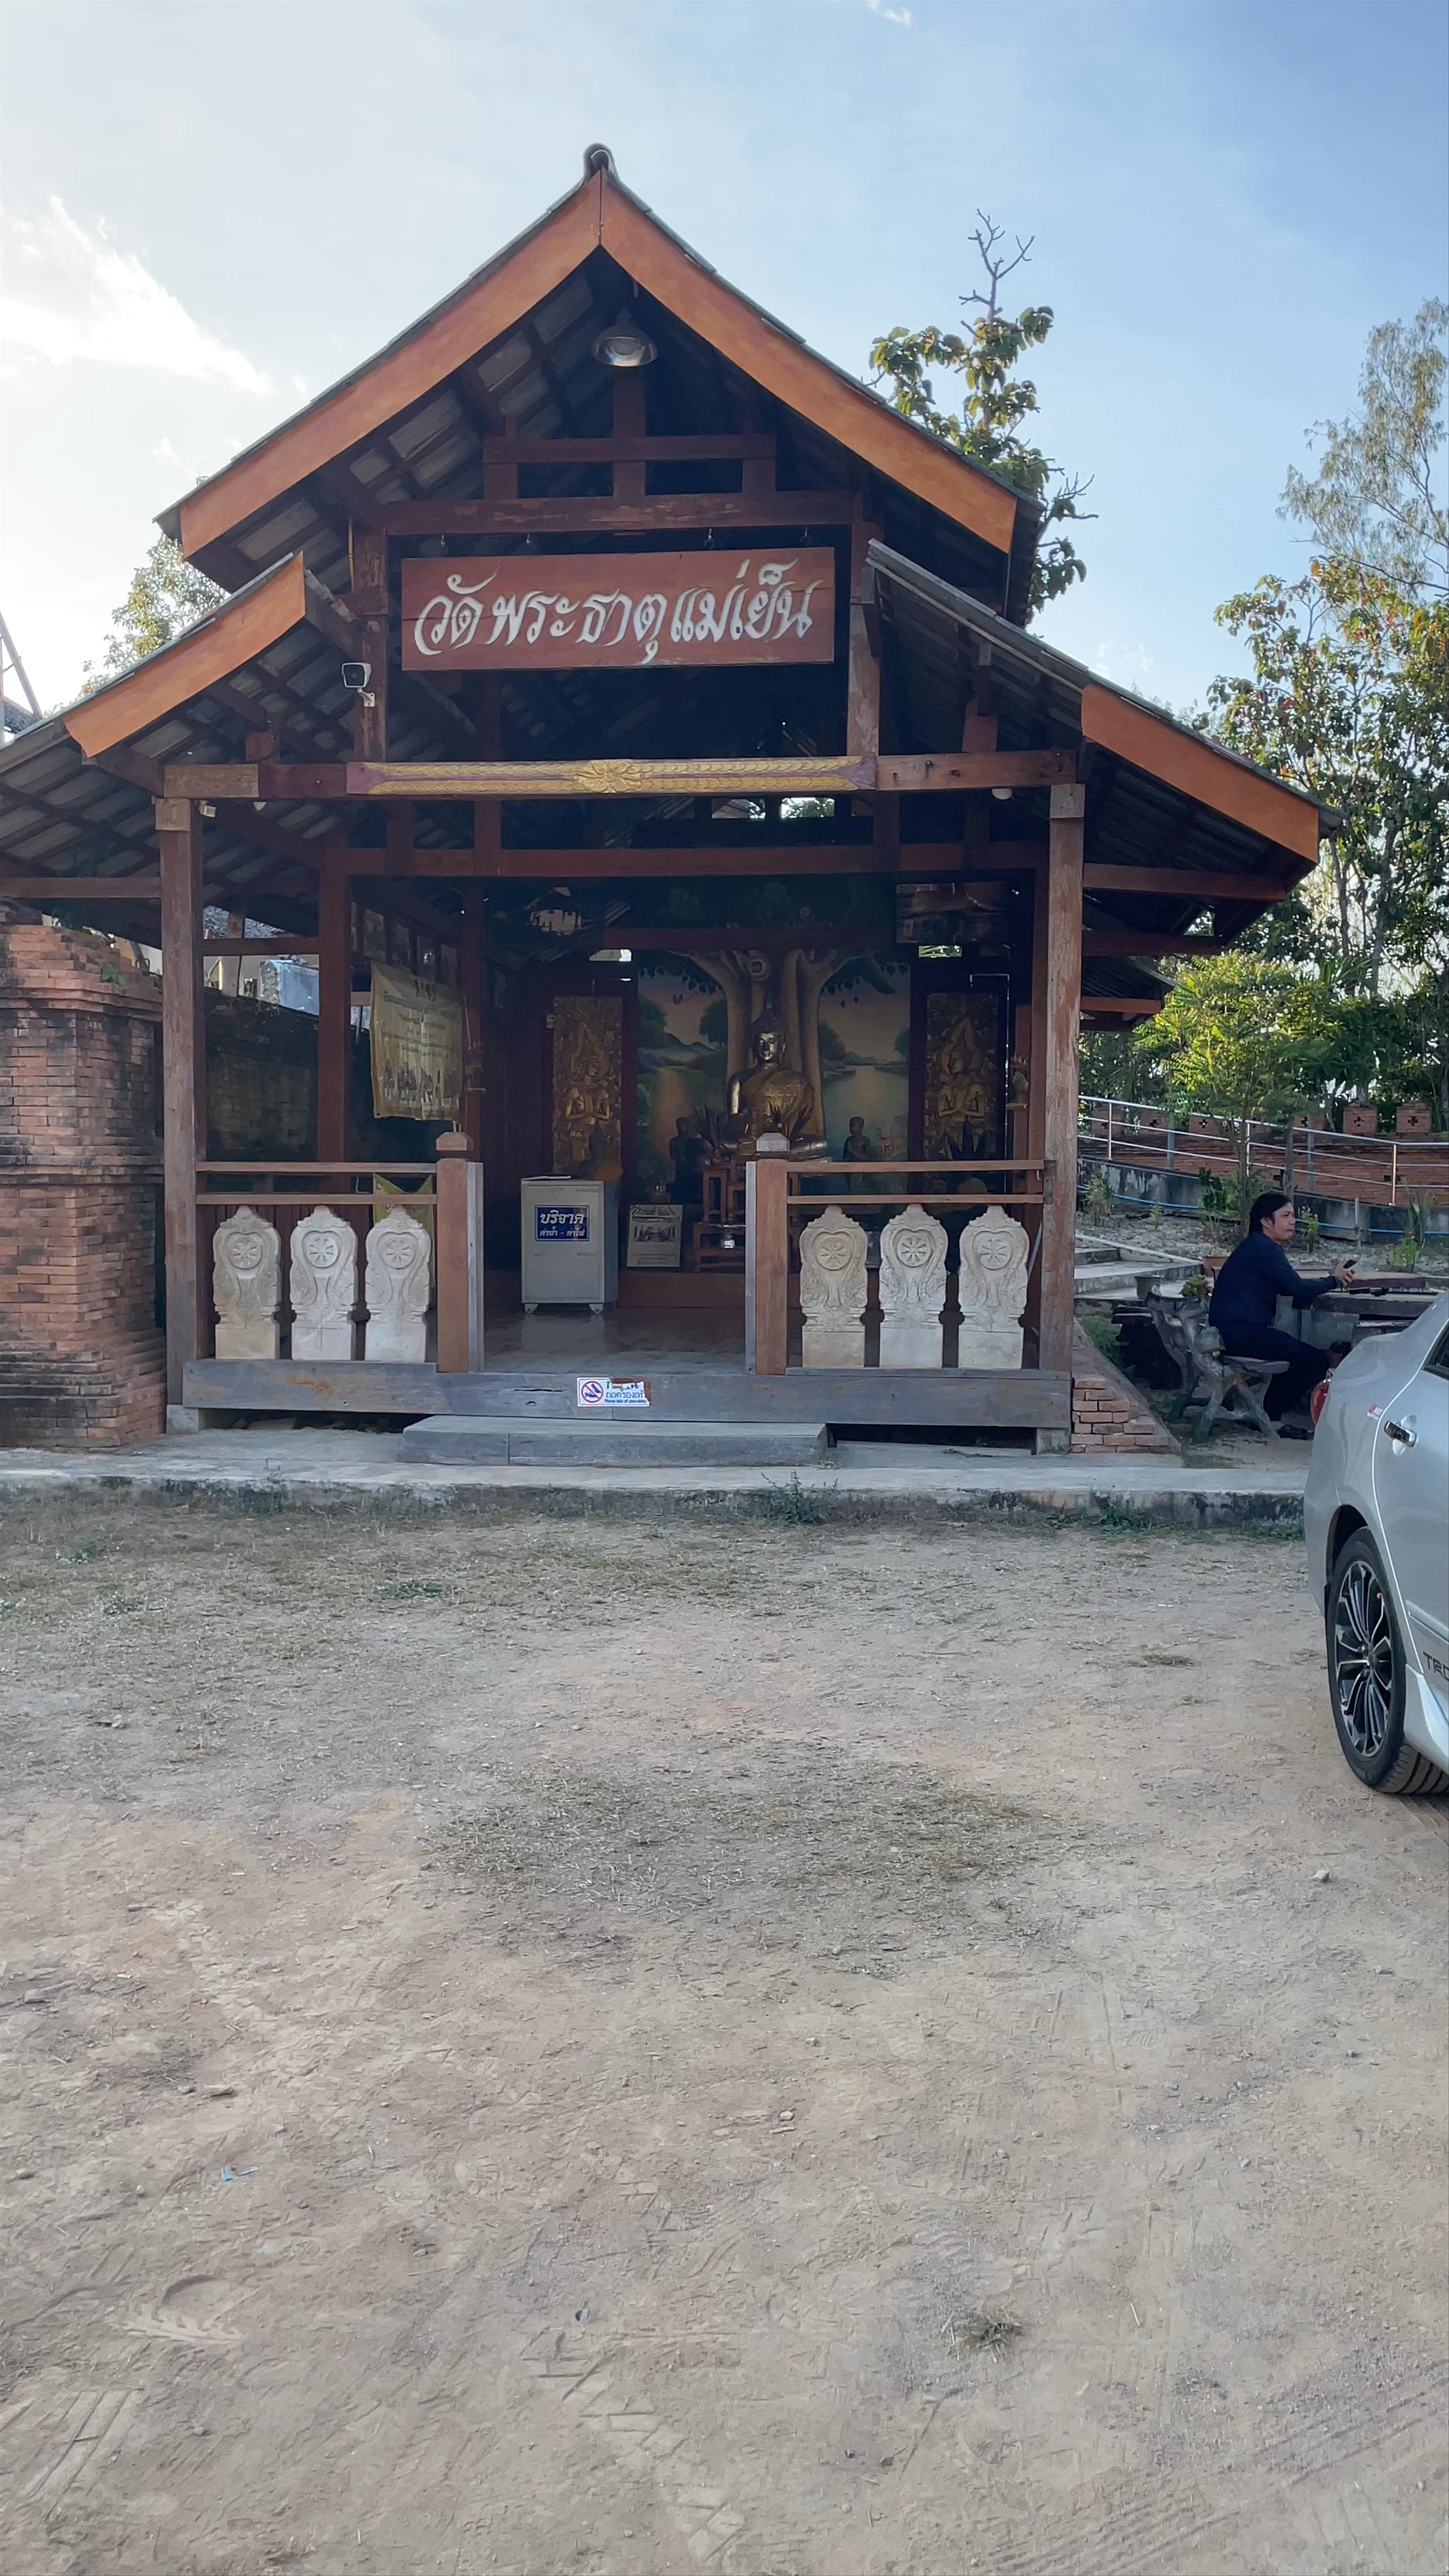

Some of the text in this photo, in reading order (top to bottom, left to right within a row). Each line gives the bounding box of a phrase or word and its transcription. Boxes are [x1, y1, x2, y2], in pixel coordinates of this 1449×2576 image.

[414, 557, 824, 665] วัดพระธาตุแม่เย็น
[540, 1209, 584, 1224] บริจาค
